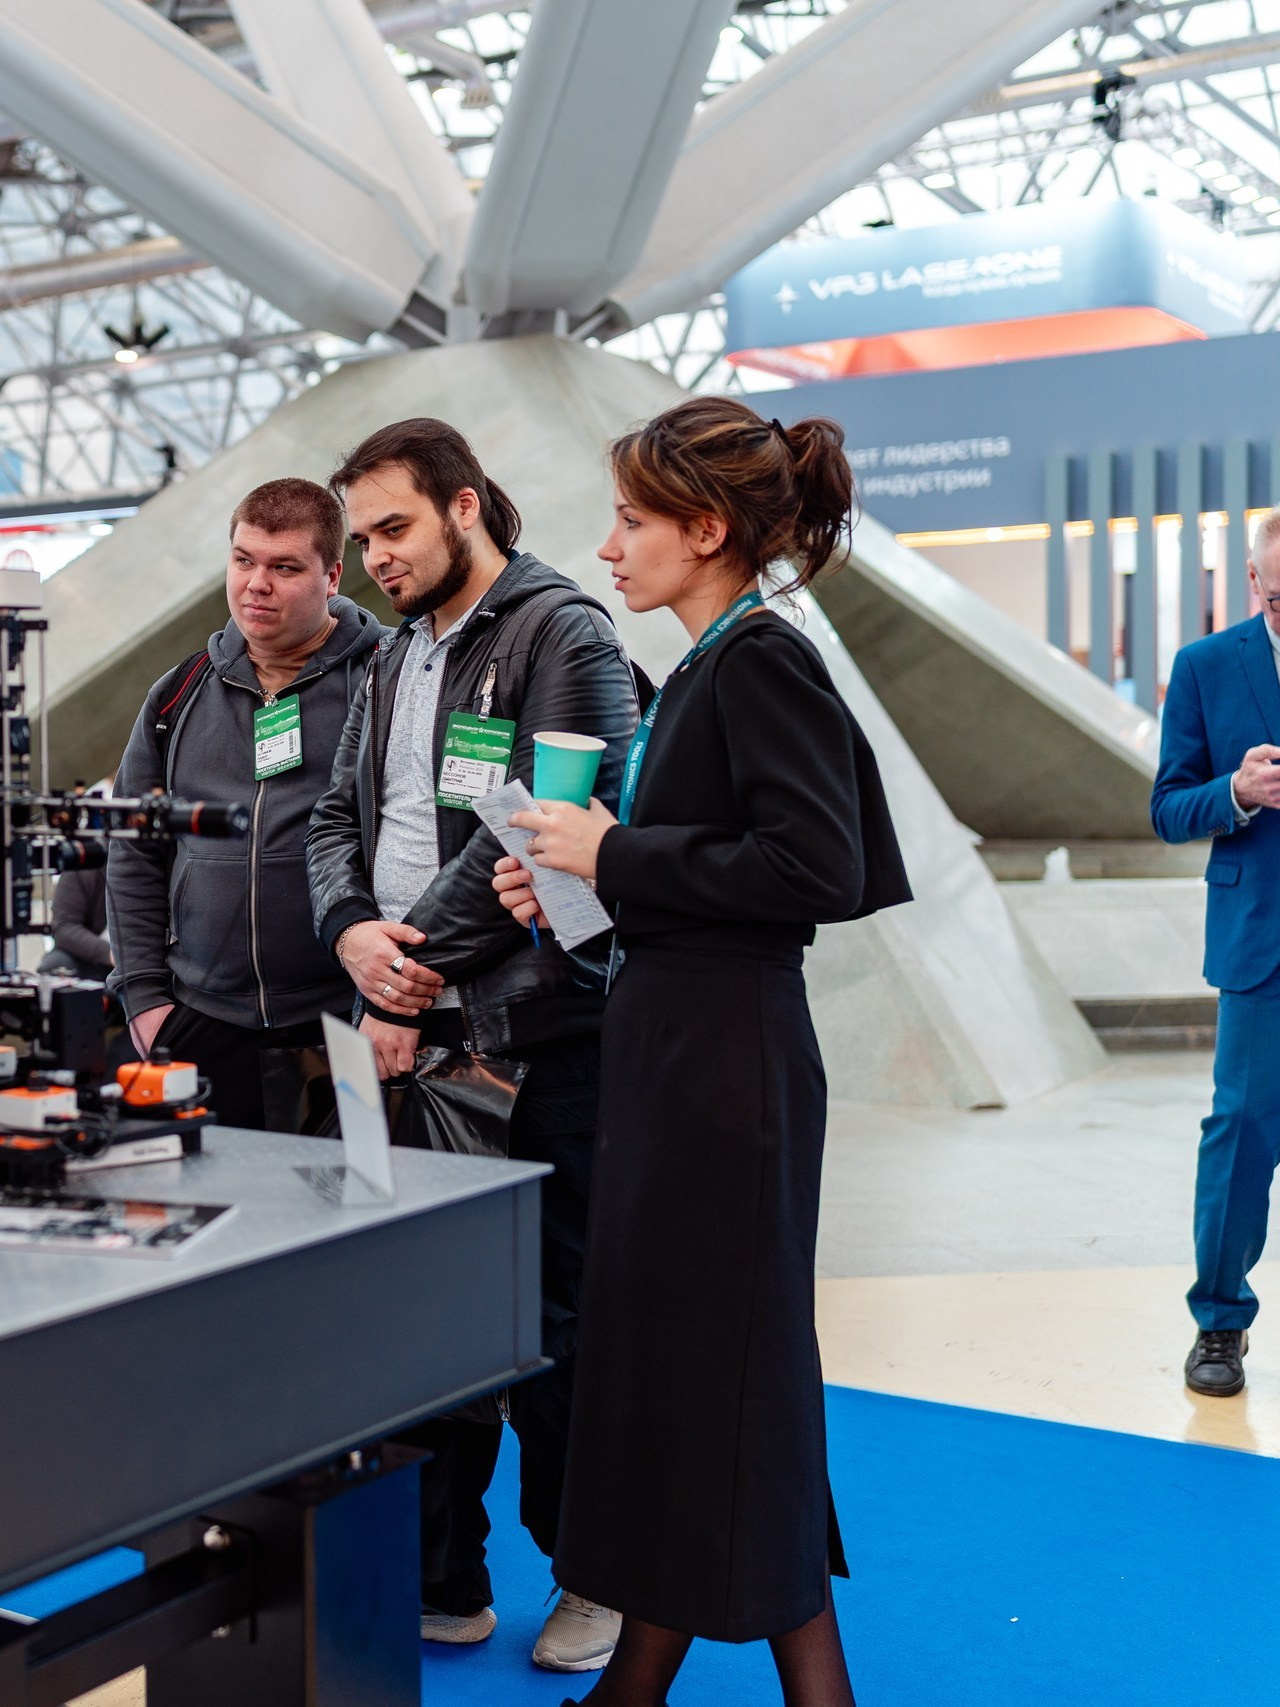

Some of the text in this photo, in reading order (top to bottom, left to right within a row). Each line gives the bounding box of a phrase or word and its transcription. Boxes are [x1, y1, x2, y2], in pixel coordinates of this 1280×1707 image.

[882, 436, 1011, 467] лидерства
[862, 467, 992, 498] индустрии
[717, 599, 753, 632] PHOTONICS
[630, 741, 644, 761] TOOLS
[438, 791, 472, 802] ПОСЕТИТЕЛЬ
[443, 798, 463, 806] VISITOR
